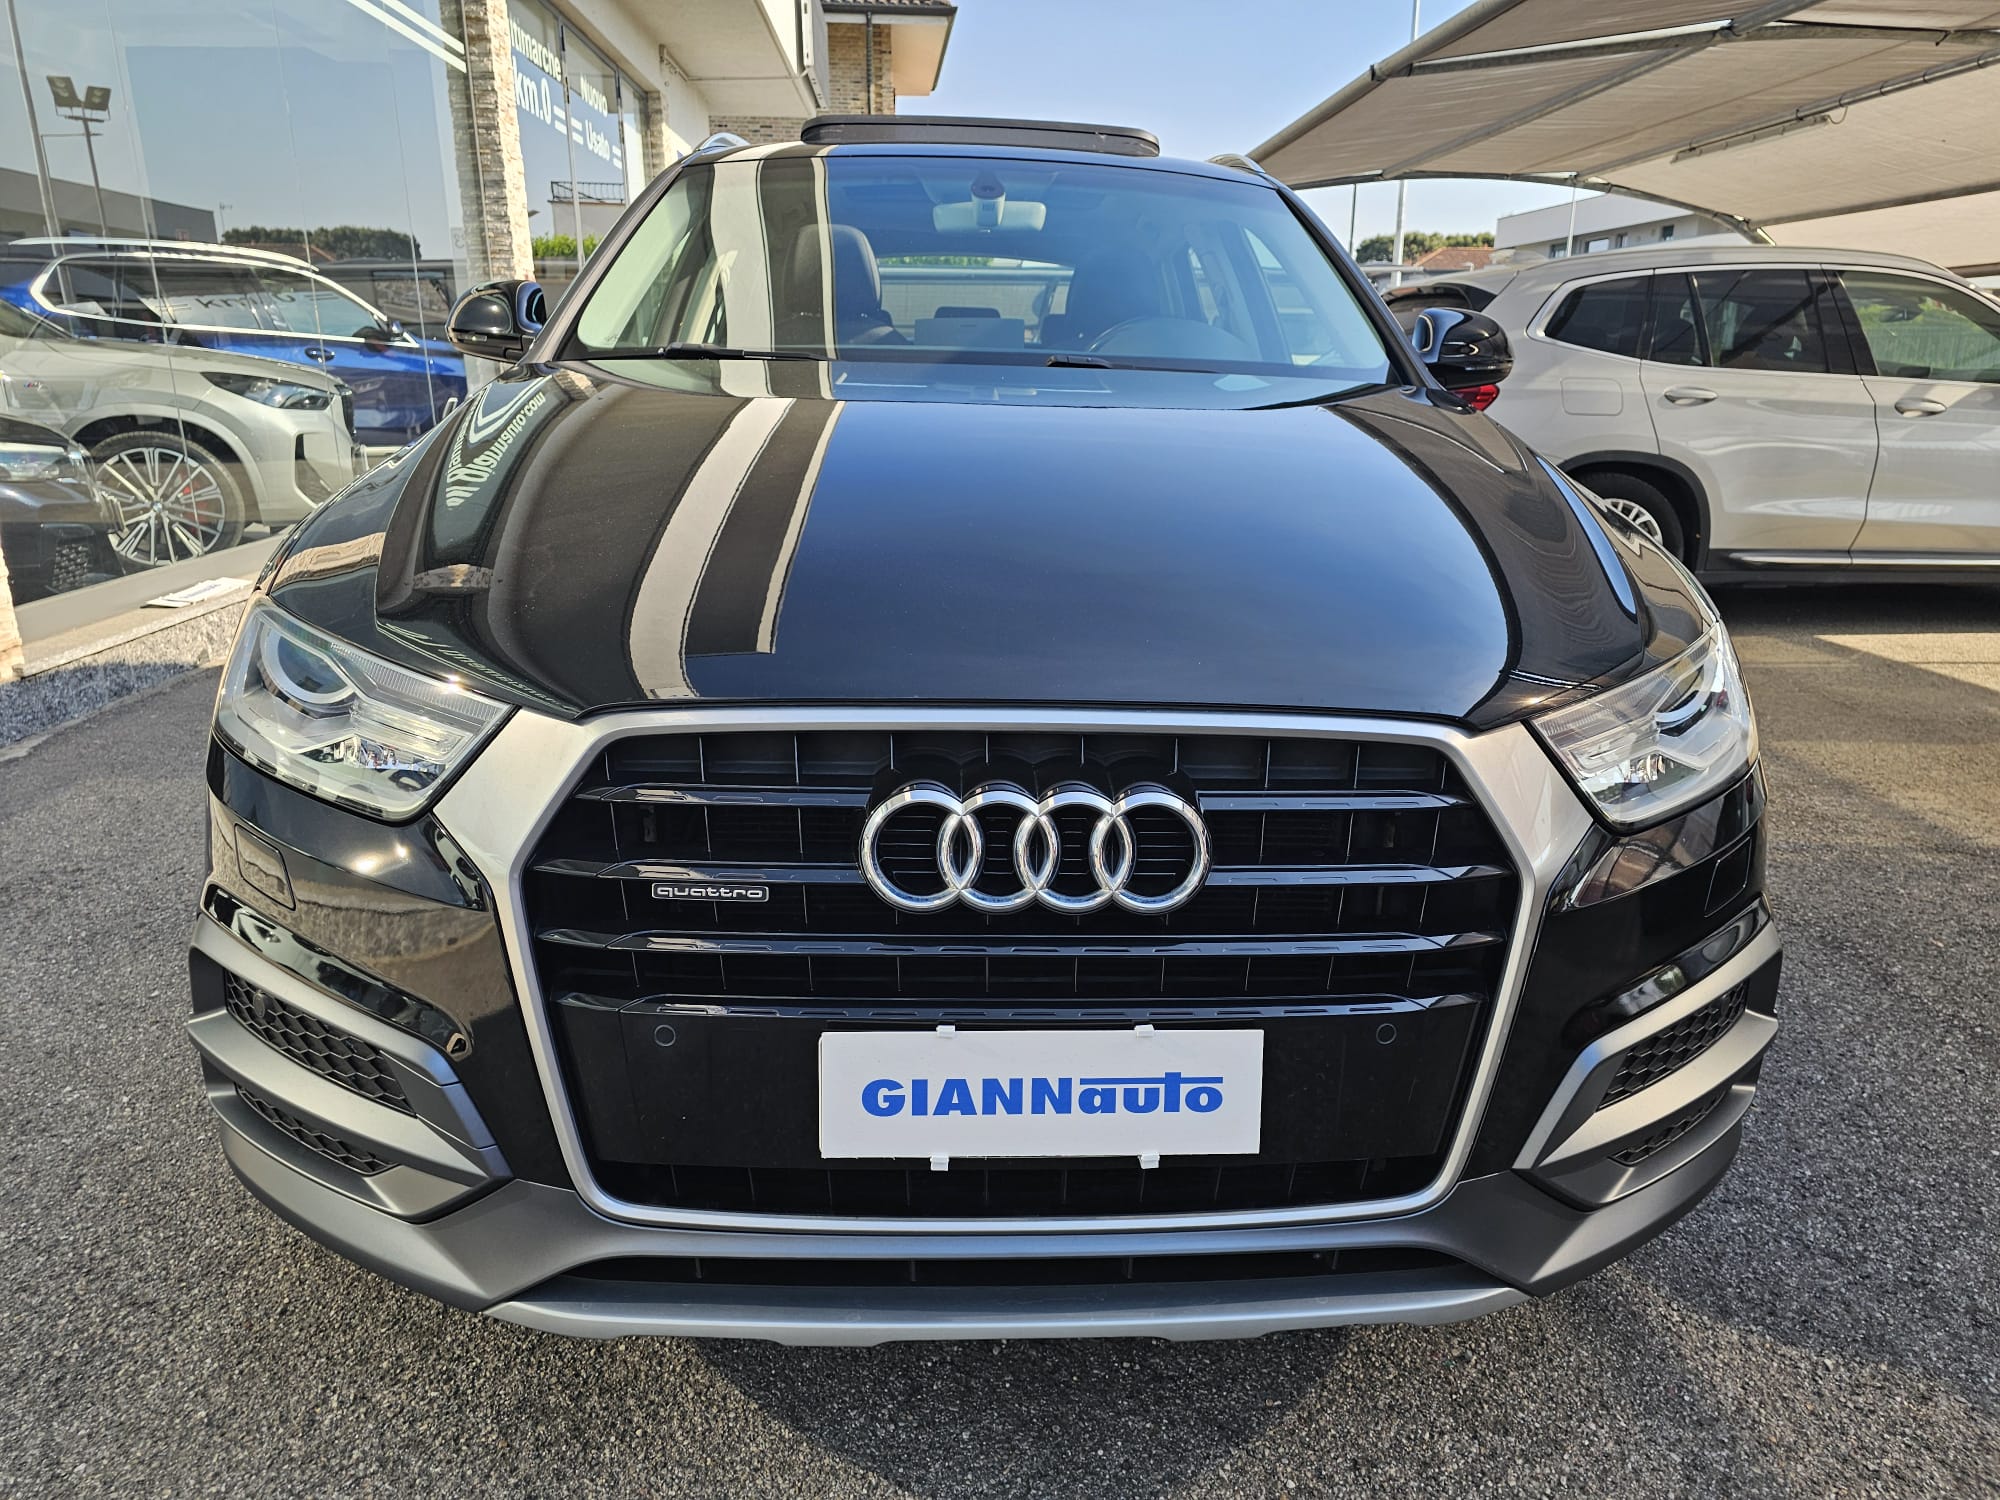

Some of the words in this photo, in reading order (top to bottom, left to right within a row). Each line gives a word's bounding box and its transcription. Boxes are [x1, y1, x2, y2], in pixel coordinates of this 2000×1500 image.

[512, 55, 551, 125] km.0
[580, 74, 608, 117] Nuovo
[585, 119, 610, 161] Usato
[656, 886, 763, 898] quattro
[861, 1071, 1224, 1117] GIANNauto
